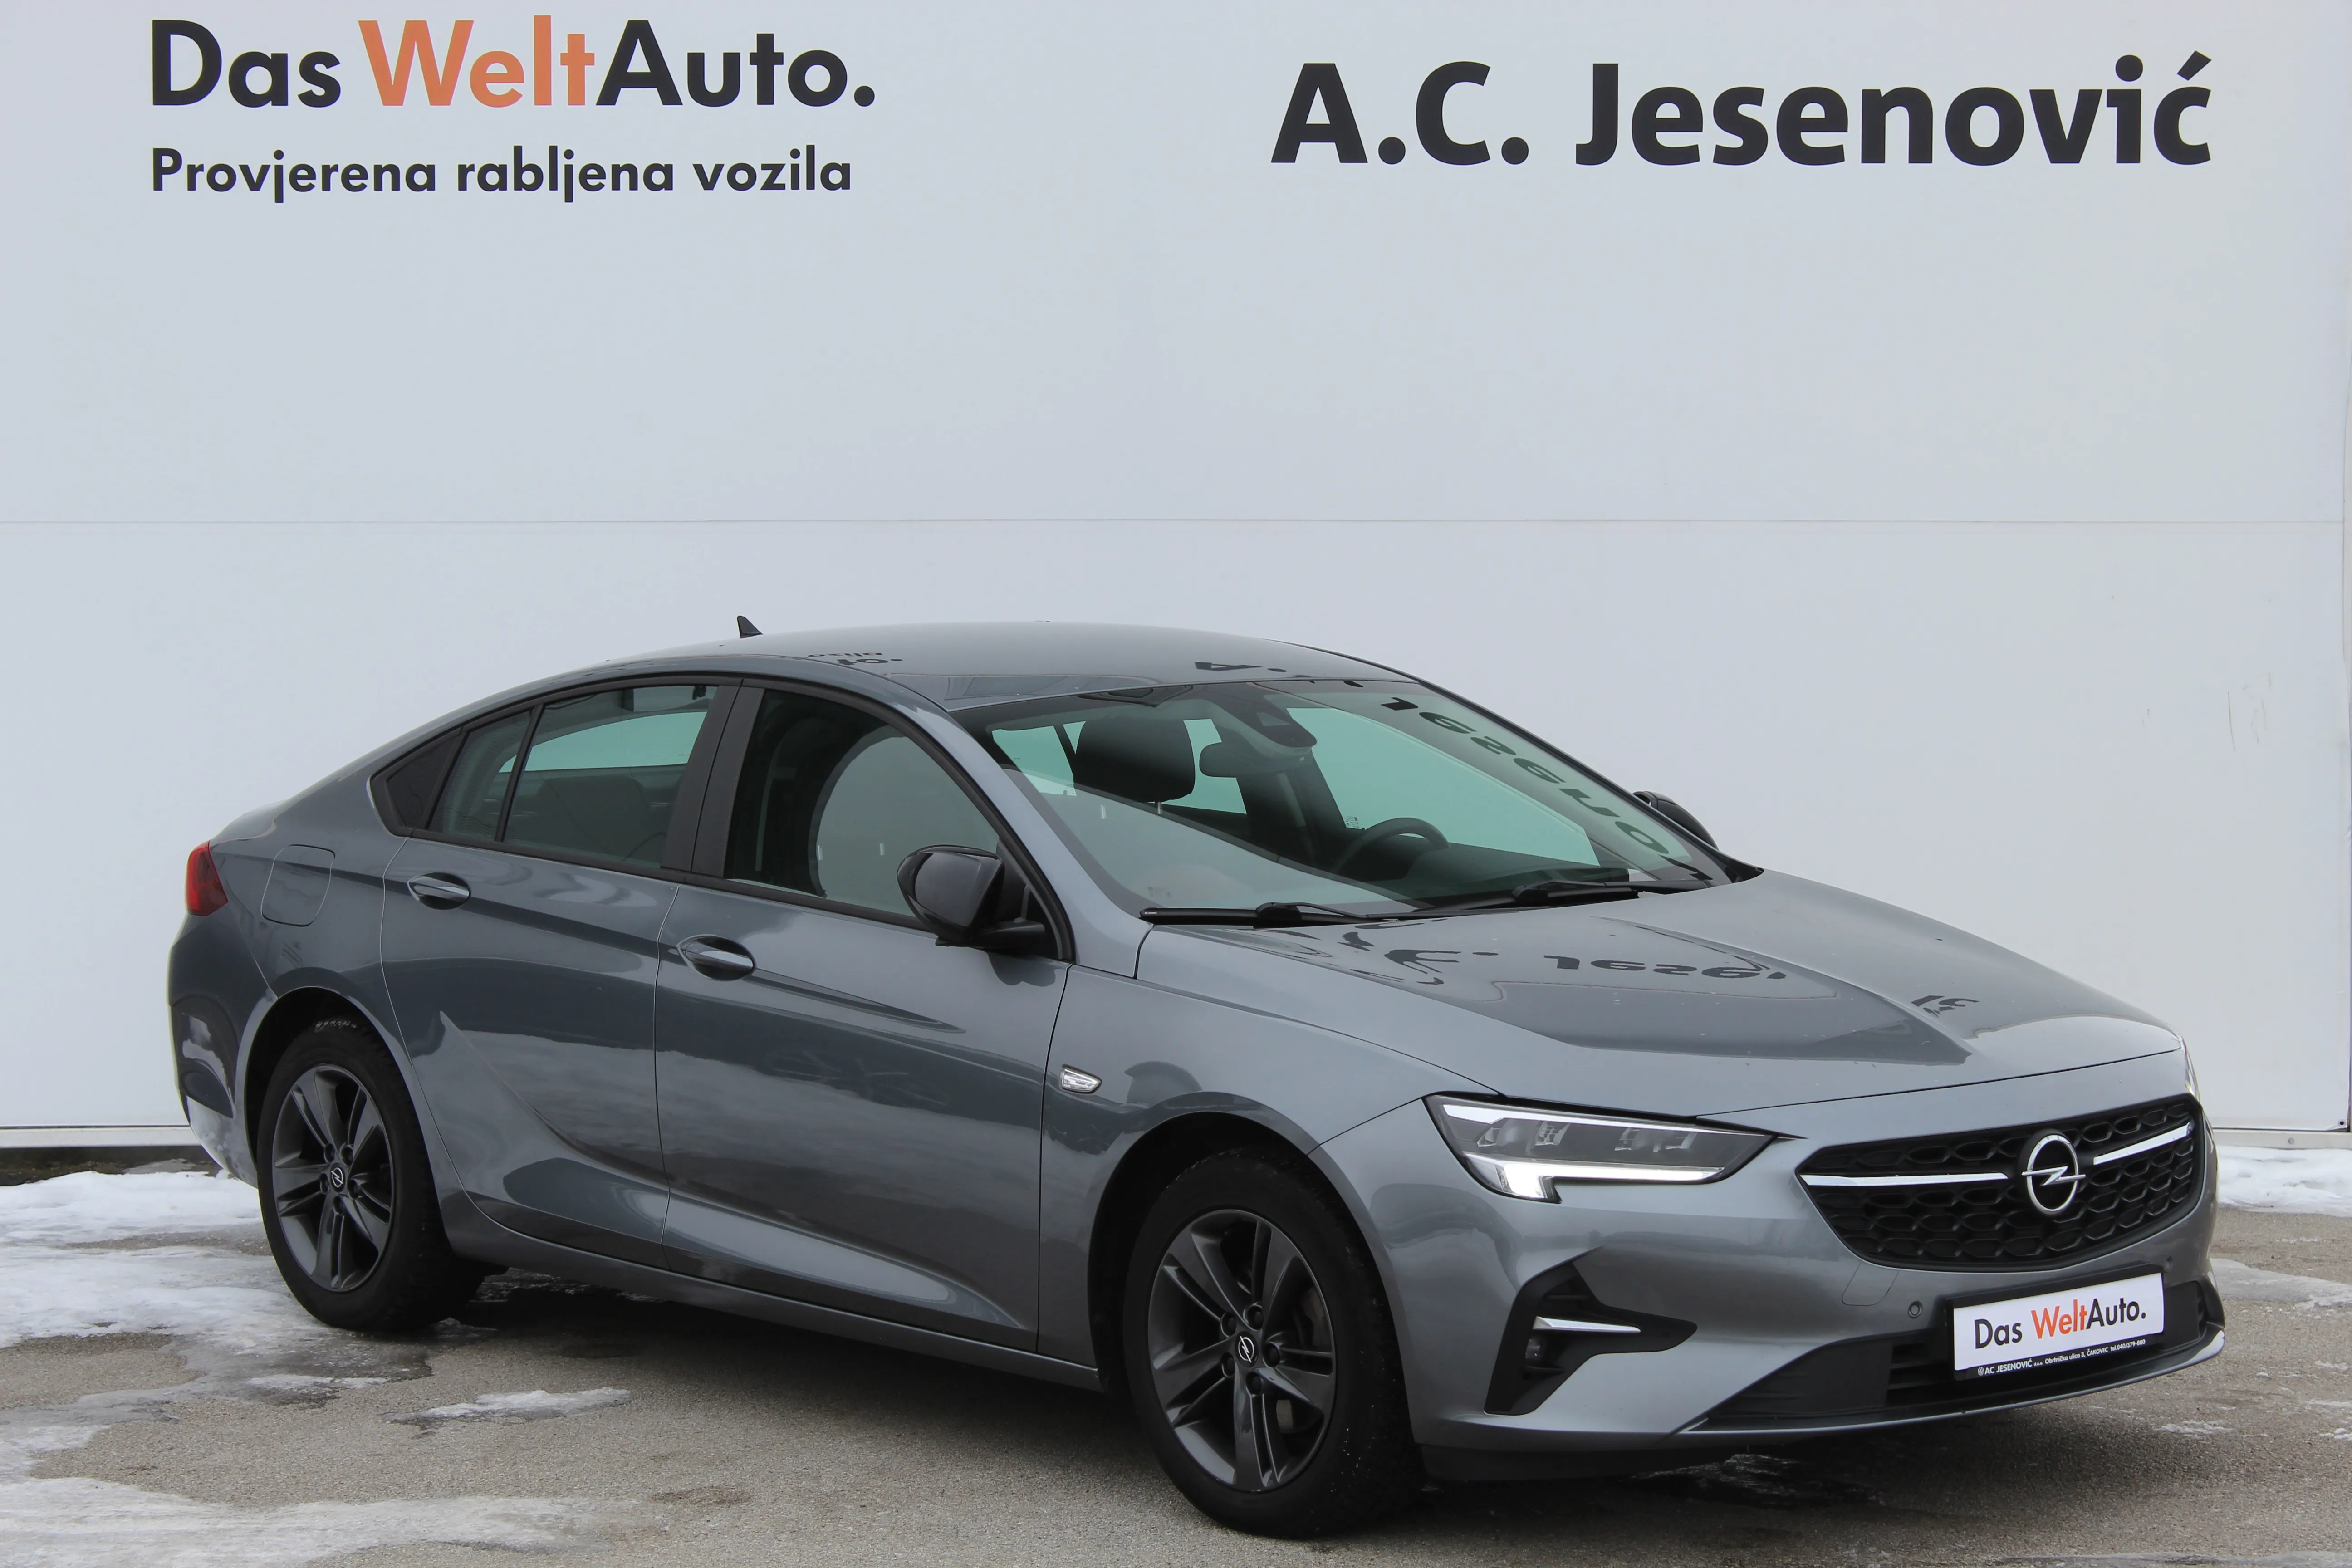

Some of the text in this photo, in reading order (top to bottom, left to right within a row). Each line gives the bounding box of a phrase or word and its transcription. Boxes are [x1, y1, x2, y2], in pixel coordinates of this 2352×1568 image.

[152, 15, 875, 108] Das WeltAuto.
[1271, 51, 2212, 166] A.C. Jesenović
[153, 145, 850, 203] Provjerena rabljena vozila
[1974, 1298, 2146, 1349] Das WeltAuto.
[1984, 1366, 1995, 1375] AC
[1996, 1358, 2032, 1372] JESENOVIĆ
[2087, 1347, 2108, 1357] ČAKOVEC
